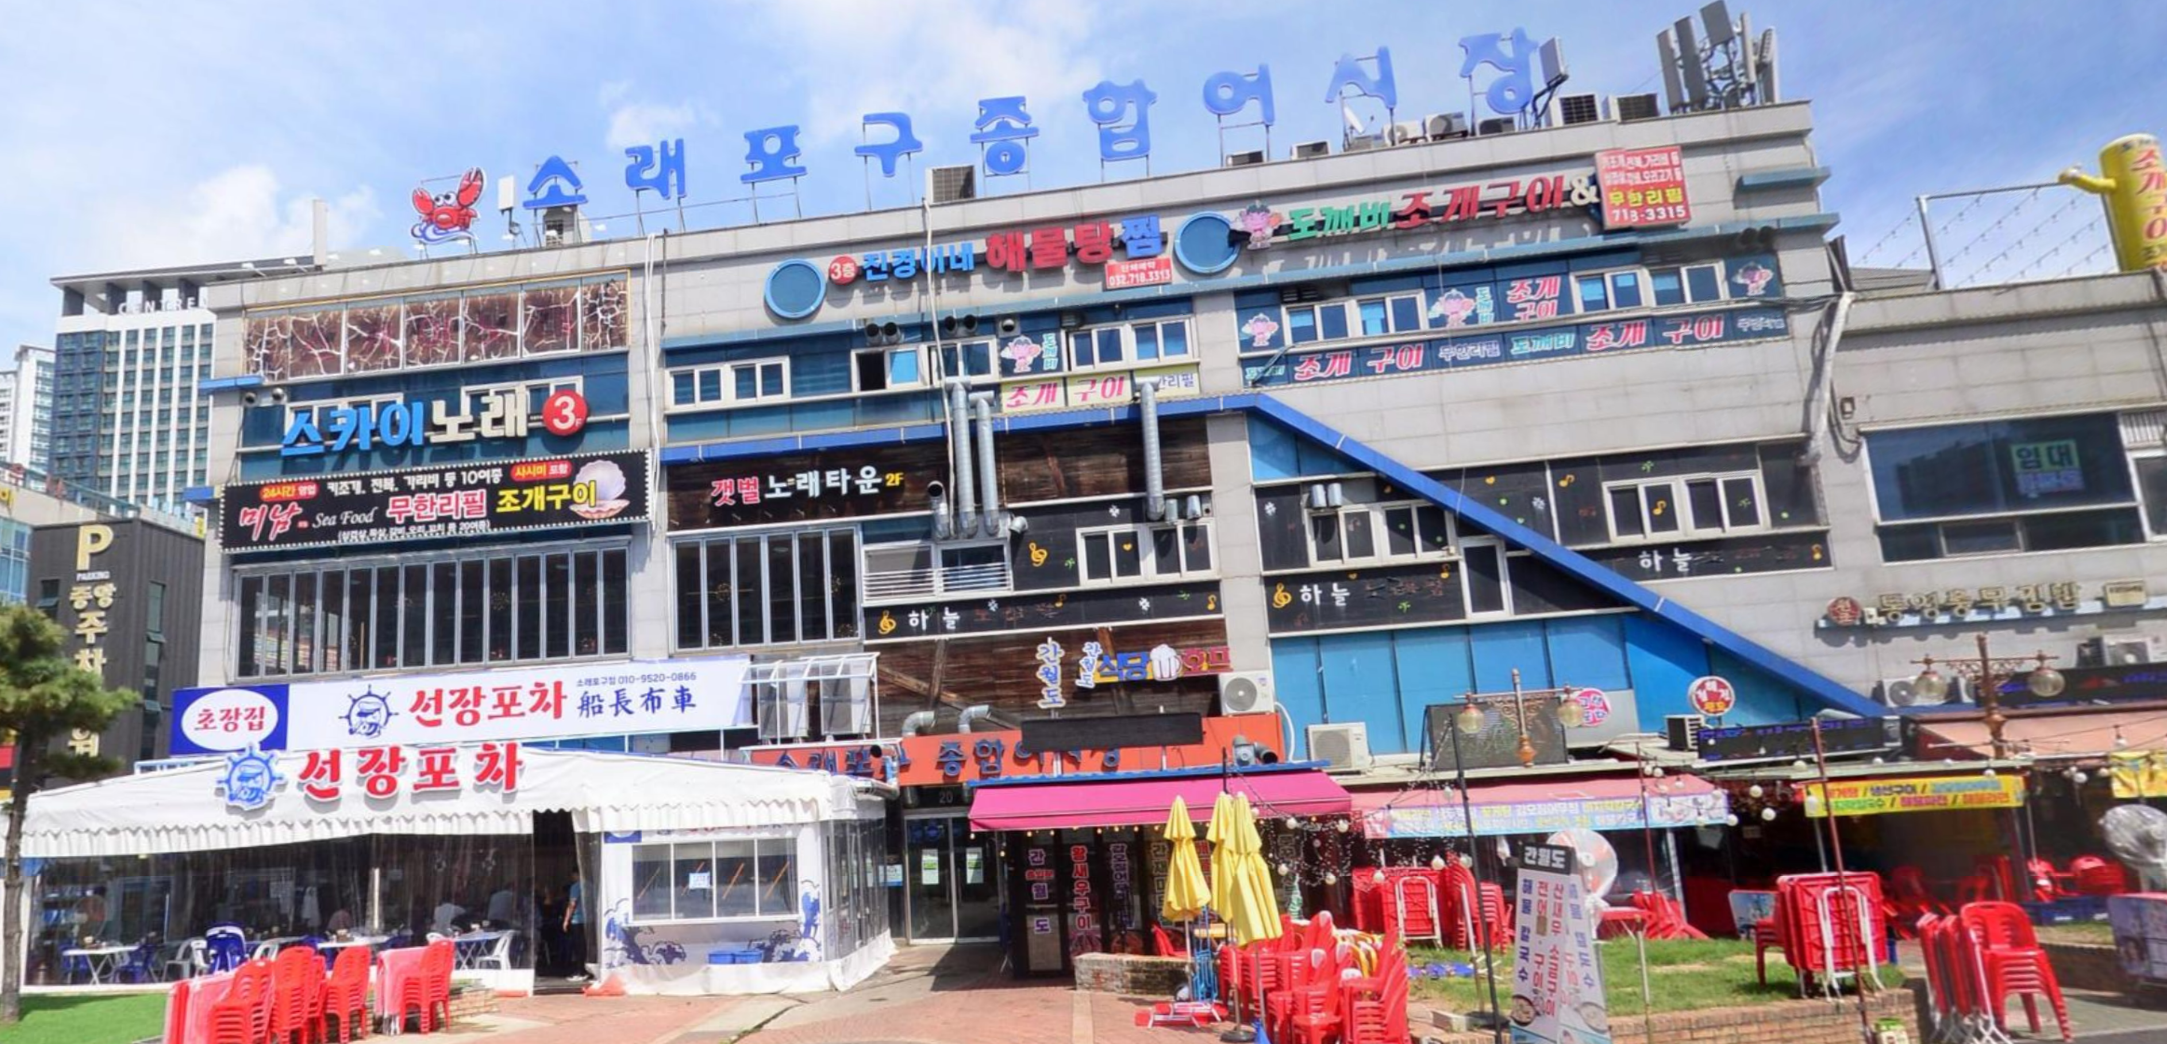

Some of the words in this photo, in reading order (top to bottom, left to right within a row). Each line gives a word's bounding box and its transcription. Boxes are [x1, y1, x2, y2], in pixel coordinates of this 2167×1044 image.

[1288, 201, 1391, 240] 도깨비
[1396, 174, 1564, 230] 조개구이
[831, 261, 855, 280] 3층
[986, 220, 1115, 272] 해물탕
[1120, 214, 1163, 258] 찜
[1507, 276, 1561, 303] 조개
[1514, 300, 1558, 323] 구이
[1294, 351, 1353, 381] 조개
[1366, 344, 1424, 374] 구이
[1438, 340, 1500, 361] 무한리필
[1511, 333, 1575, 355] 도깨비
[1586, 320, 1646, 351] 조개
[1662, 315, 1724, 344] 구이
[1006, 382, 1058, 408] 조개
[1073, 375, 1125, 404] 구이
[514, 463, 546, 478] 사시미
[549, 463, 569, 476] 포함
[2016, 443, 2074, 469] 임대
[403, 473, 440, 490] 가리비
[444, 471, 456, 487] 등
[461, 468, 503, 485] 10여종
[764, 465, 882, 499] 노래타운
[885, 472, 904, 487] 2F
[240, 501, 303, 541] 미남
[312, 512, 336, 528] Sea
[340, 507, 379, 526] Food
[386, 488, 487, 525] 무한리필
[496, 480, 597, 513] 조개구이
[76, 524, 114, 571] P
[1638, 547, 1692, 572] 하늘
[76, 570, 110, 581] PARKING
[1300, 582, 1350, 606] 하늘
[908, 609, 961, 632] 하늘
[618, 671, 698, 685] 010-9520-0866
[1037, 641, 1065, 708] 간월도
[1098, 651, 1150, 681] 식당
[194, 702, 267, 733] 초장집
[409, 679, 567, 729] 선장포차
[299, 743, 524, 800] 선장포차
[937, 739, 1005, 776] 종합
[1523, 845, 1566, 868] 간월도
[1522, 878, 1533, 915] 해물
[1518, 925, 1531, 982] 칼국수
